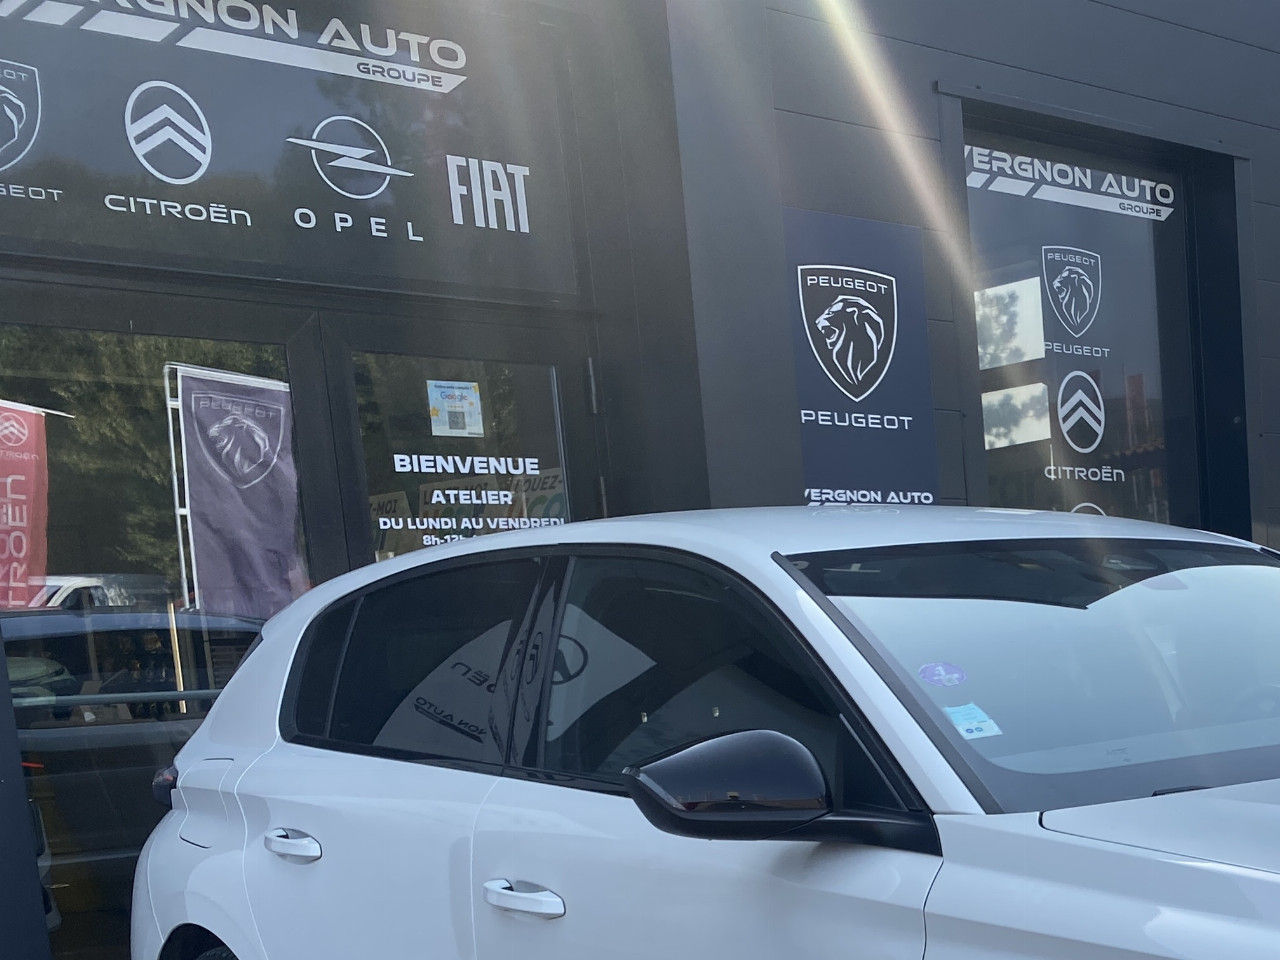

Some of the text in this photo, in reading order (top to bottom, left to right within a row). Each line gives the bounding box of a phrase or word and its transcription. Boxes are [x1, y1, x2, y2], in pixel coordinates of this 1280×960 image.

[317, 17, 467, 69] AUTO
[356, 62, 443, 87] GROUPE
[446, 155, 530, 233] FIAT
[1100, 173, 1175, 204] AUTO
[1118, 202, 1162, 217] GROUPE
[294, 208, 424, 242] OPEL
[1047, 252, 1096, 266] PEUGEOT
[806, 276, 889, 295] PEUGEOT
[1044, 342, 1110, 358] PEUGEOT
[440, 391, 468, 402] Google
[801, 410, 913, 430] PEUGEOT
[393, 454, 540, 475] BIENVENUE
[431, 490, 513, 505] ATELIER
[886, 491, 934, 504] AUTO
[379, 517, 565, 529] DU LUNDI AU VENDREDI
